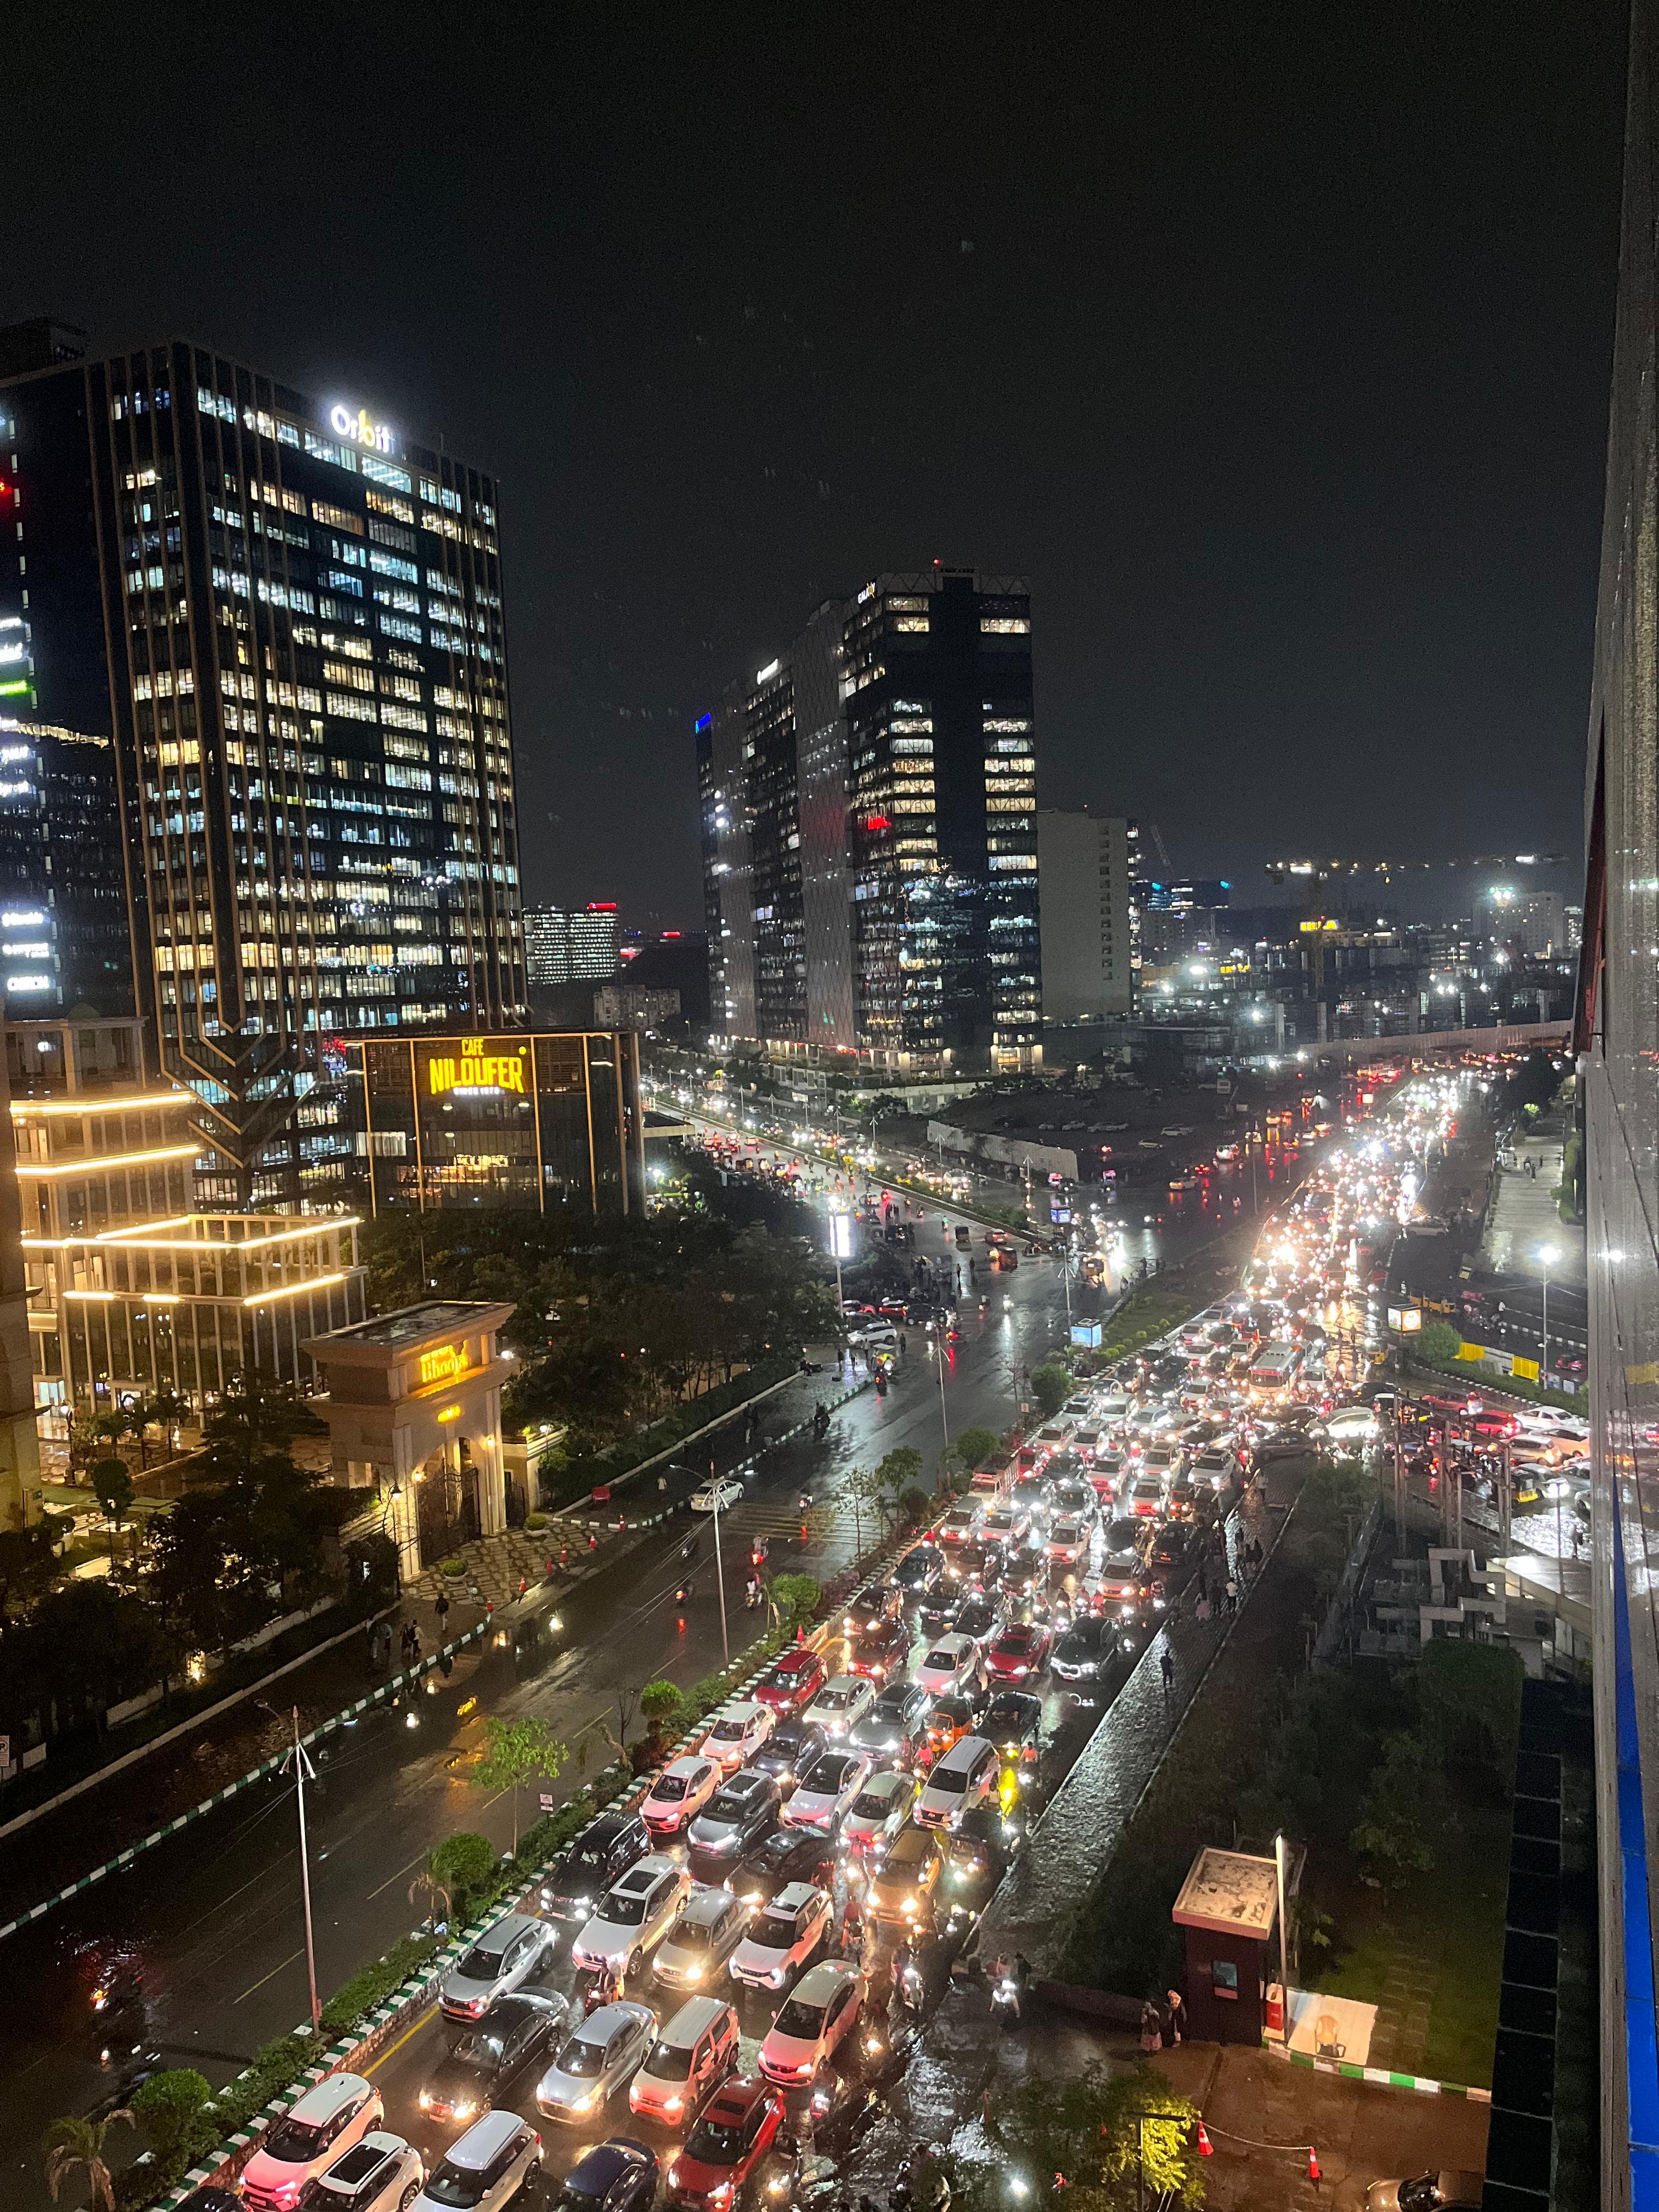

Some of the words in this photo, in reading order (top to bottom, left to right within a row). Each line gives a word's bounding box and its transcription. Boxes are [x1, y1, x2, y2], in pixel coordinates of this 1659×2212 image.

[331, 405, 390, 453] Orbit
[461, 1039, 484, 1056] CAFE
[430, 1057, 524, 1094] NILOUFER
